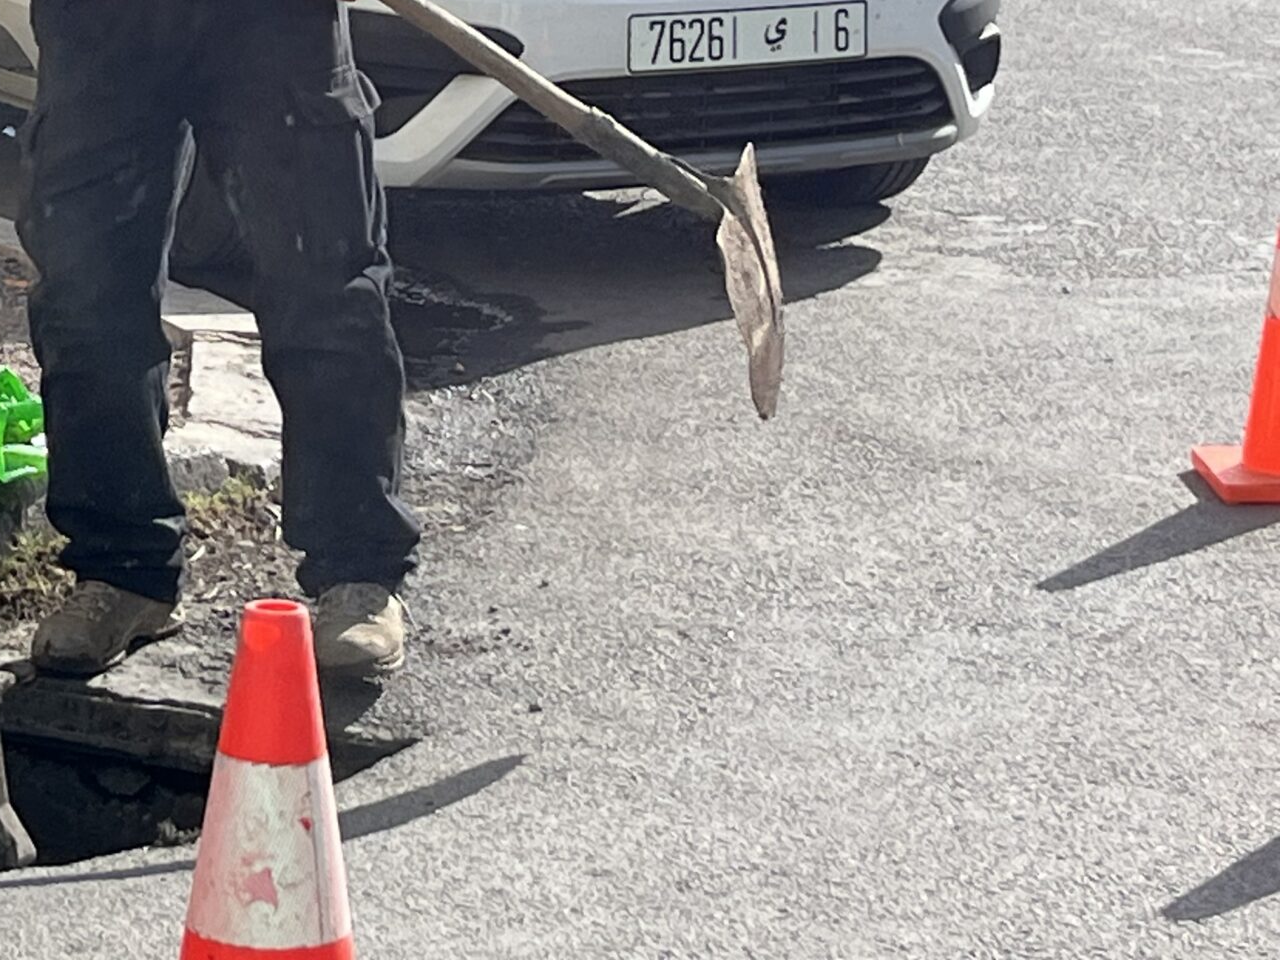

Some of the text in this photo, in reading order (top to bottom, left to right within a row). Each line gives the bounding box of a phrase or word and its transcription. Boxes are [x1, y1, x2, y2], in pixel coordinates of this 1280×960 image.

[649, 8, 850, 65] 7626 ي 6
